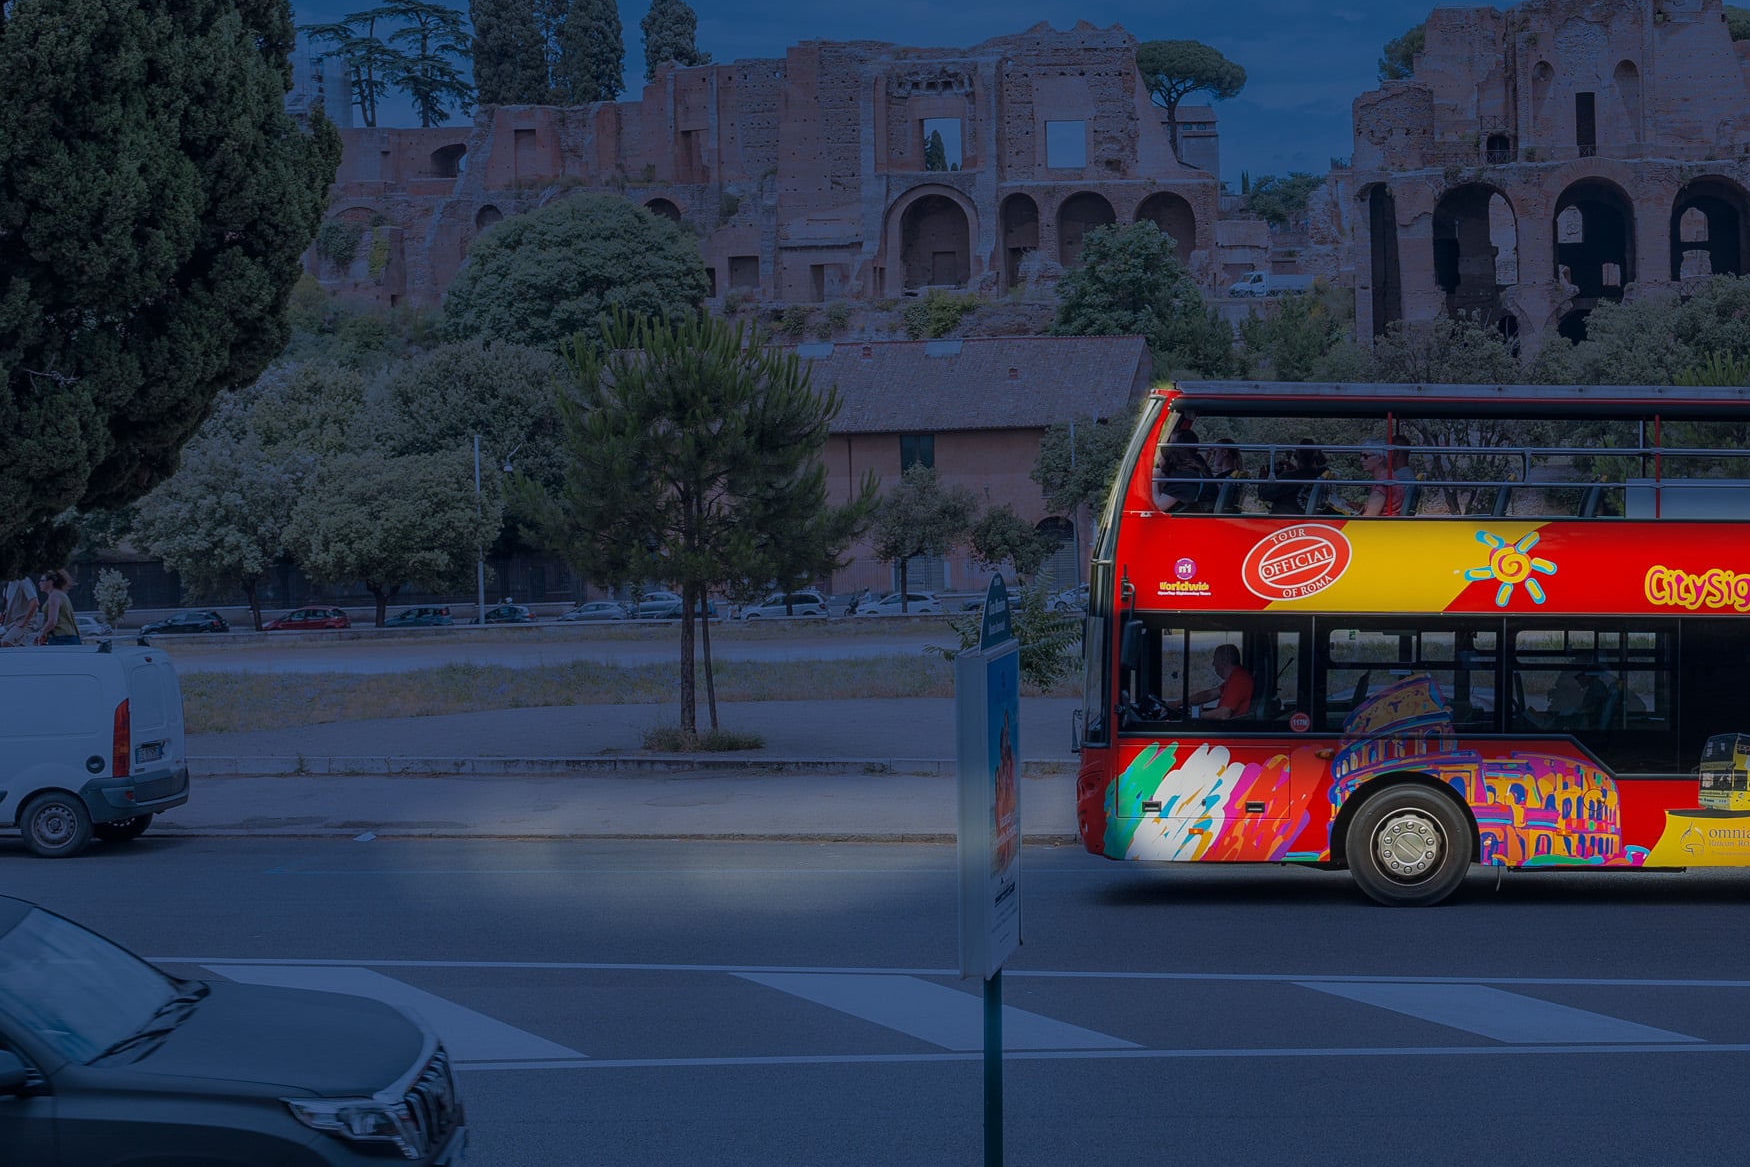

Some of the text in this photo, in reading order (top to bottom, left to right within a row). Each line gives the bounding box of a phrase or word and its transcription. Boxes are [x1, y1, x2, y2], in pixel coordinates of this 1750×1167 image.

[1270, 528, 1307, 546] TOUR
[1261, 547, 1333, 578] OFFICIAL
[1282, 574, 1334, 599] OF ROMA
